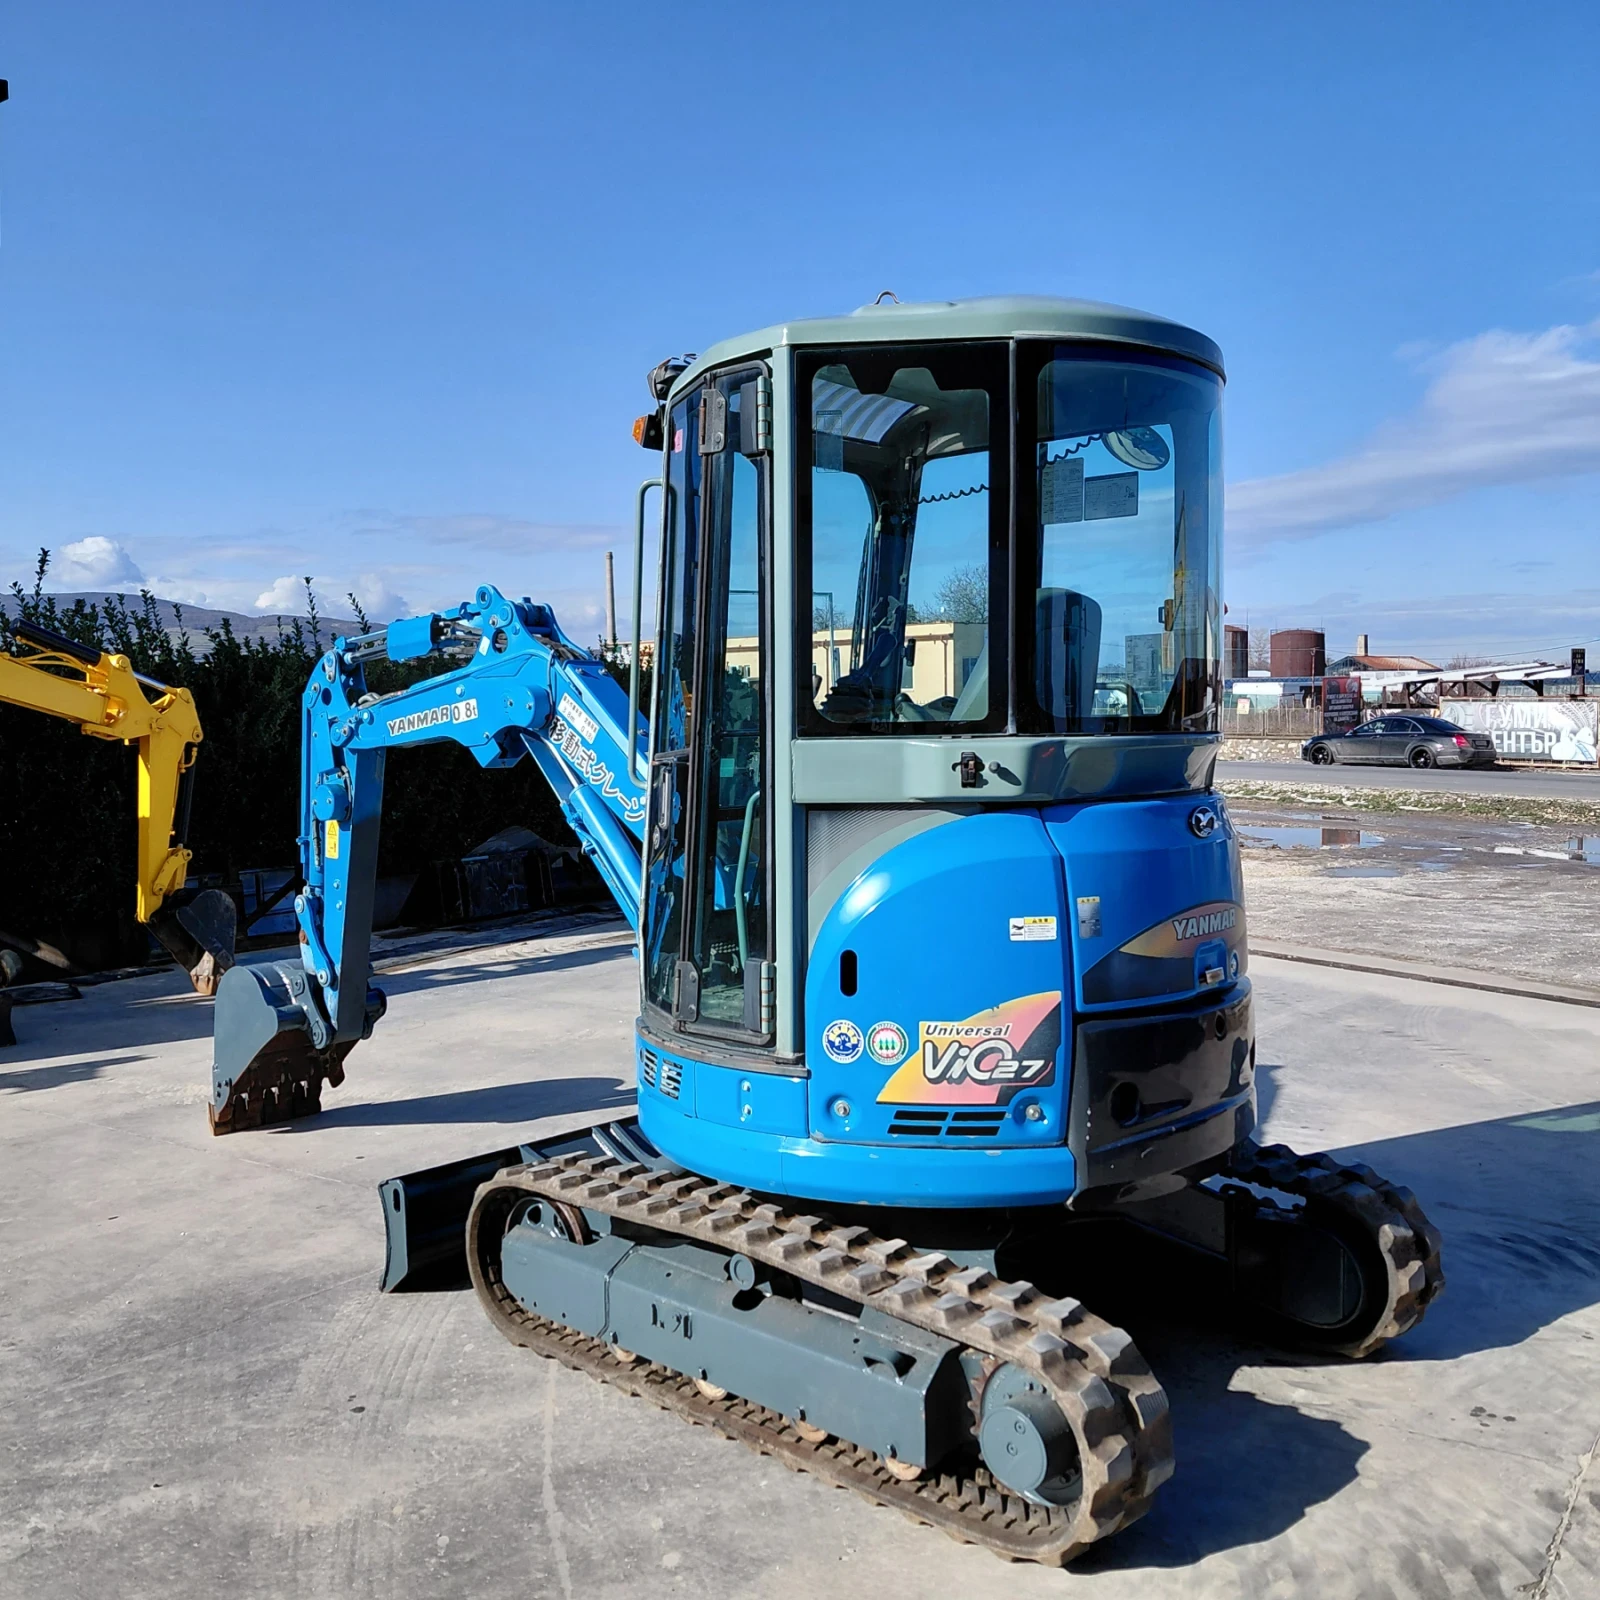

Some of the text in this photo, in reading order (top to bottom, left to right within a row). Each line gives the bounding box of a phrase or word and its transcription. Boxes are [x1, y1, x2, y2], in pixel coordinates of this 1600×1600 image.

[387, 705, 450, 735] YANMAR
[1485, 704, 1549, 729] ГУМИ
[1477, 730, 1556, 754] ЕНТЪР
[1173, 908, 1236, 940] YANMAR
[925, 1023, 1011, 1037] Universal
